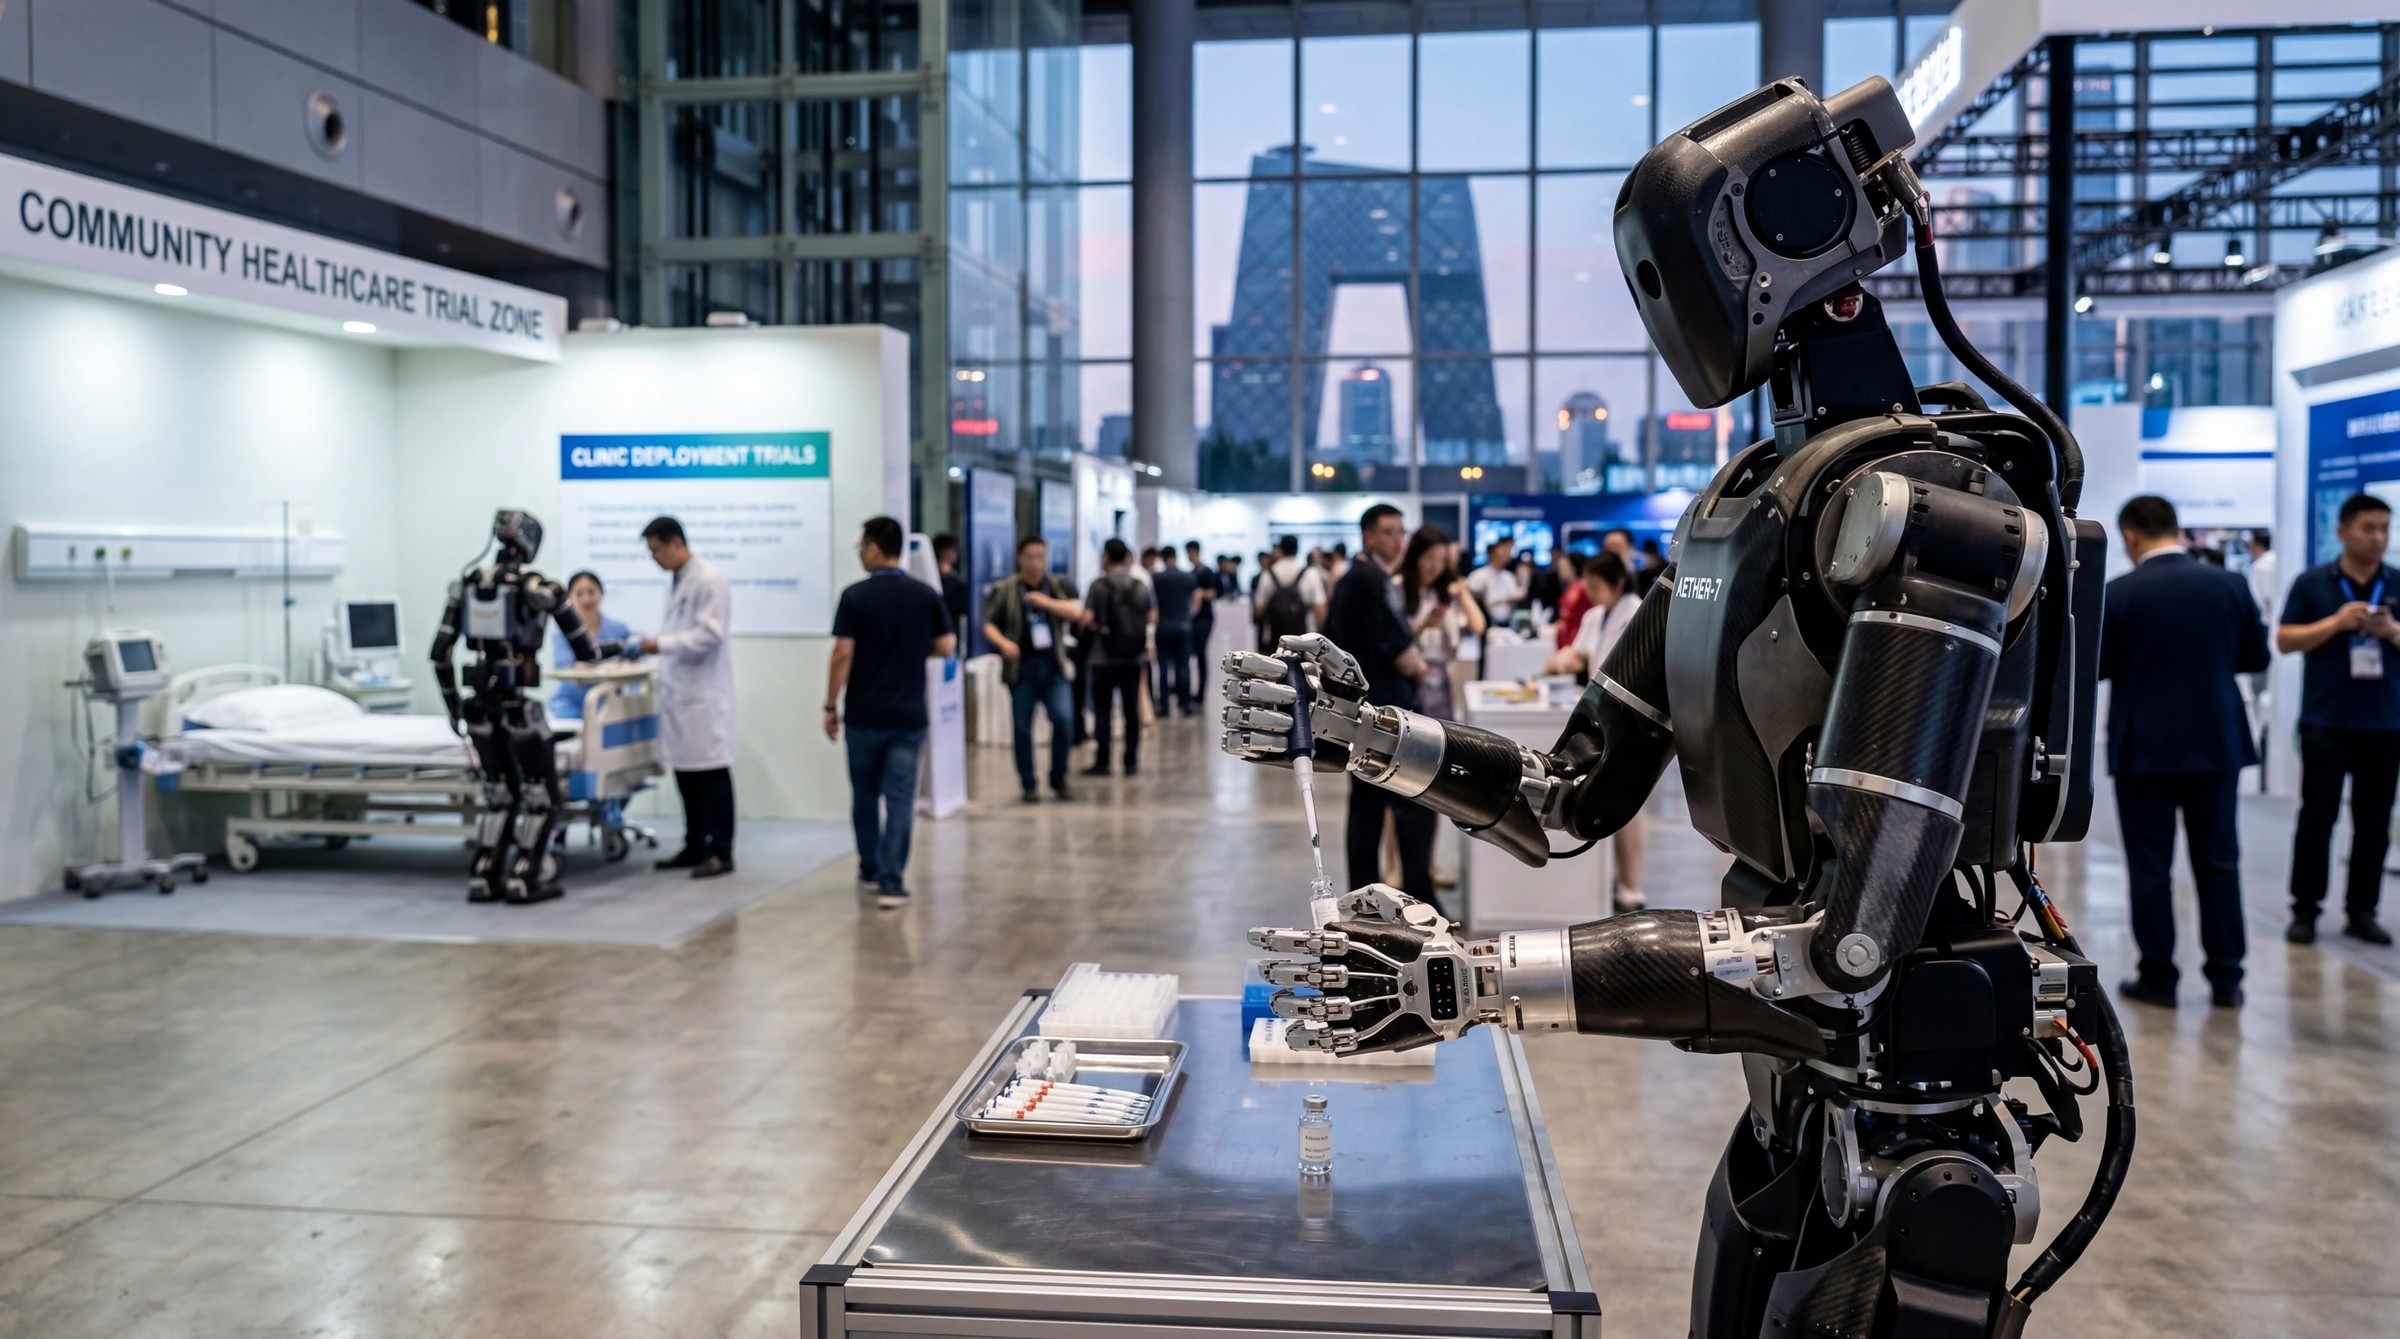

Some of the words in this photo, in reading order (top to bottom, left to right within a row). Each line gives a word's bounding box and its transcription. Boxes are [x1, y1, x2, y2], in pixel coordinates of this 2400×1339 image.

[19, 190, 233, 274] COMMUNITY
[242, 242, 416, 314] HEALTHCARE
[422, 284, 485, 329] TRIAL
[489, 299, 544, 340] ZONE
[570, 446, 629, 468] CLINIC
[631, 445, 749, 467] DEPLOYMENT
[754, 444, 817, 466] TRIALS
[1675, 576, 1722, 601] AETHER-7
